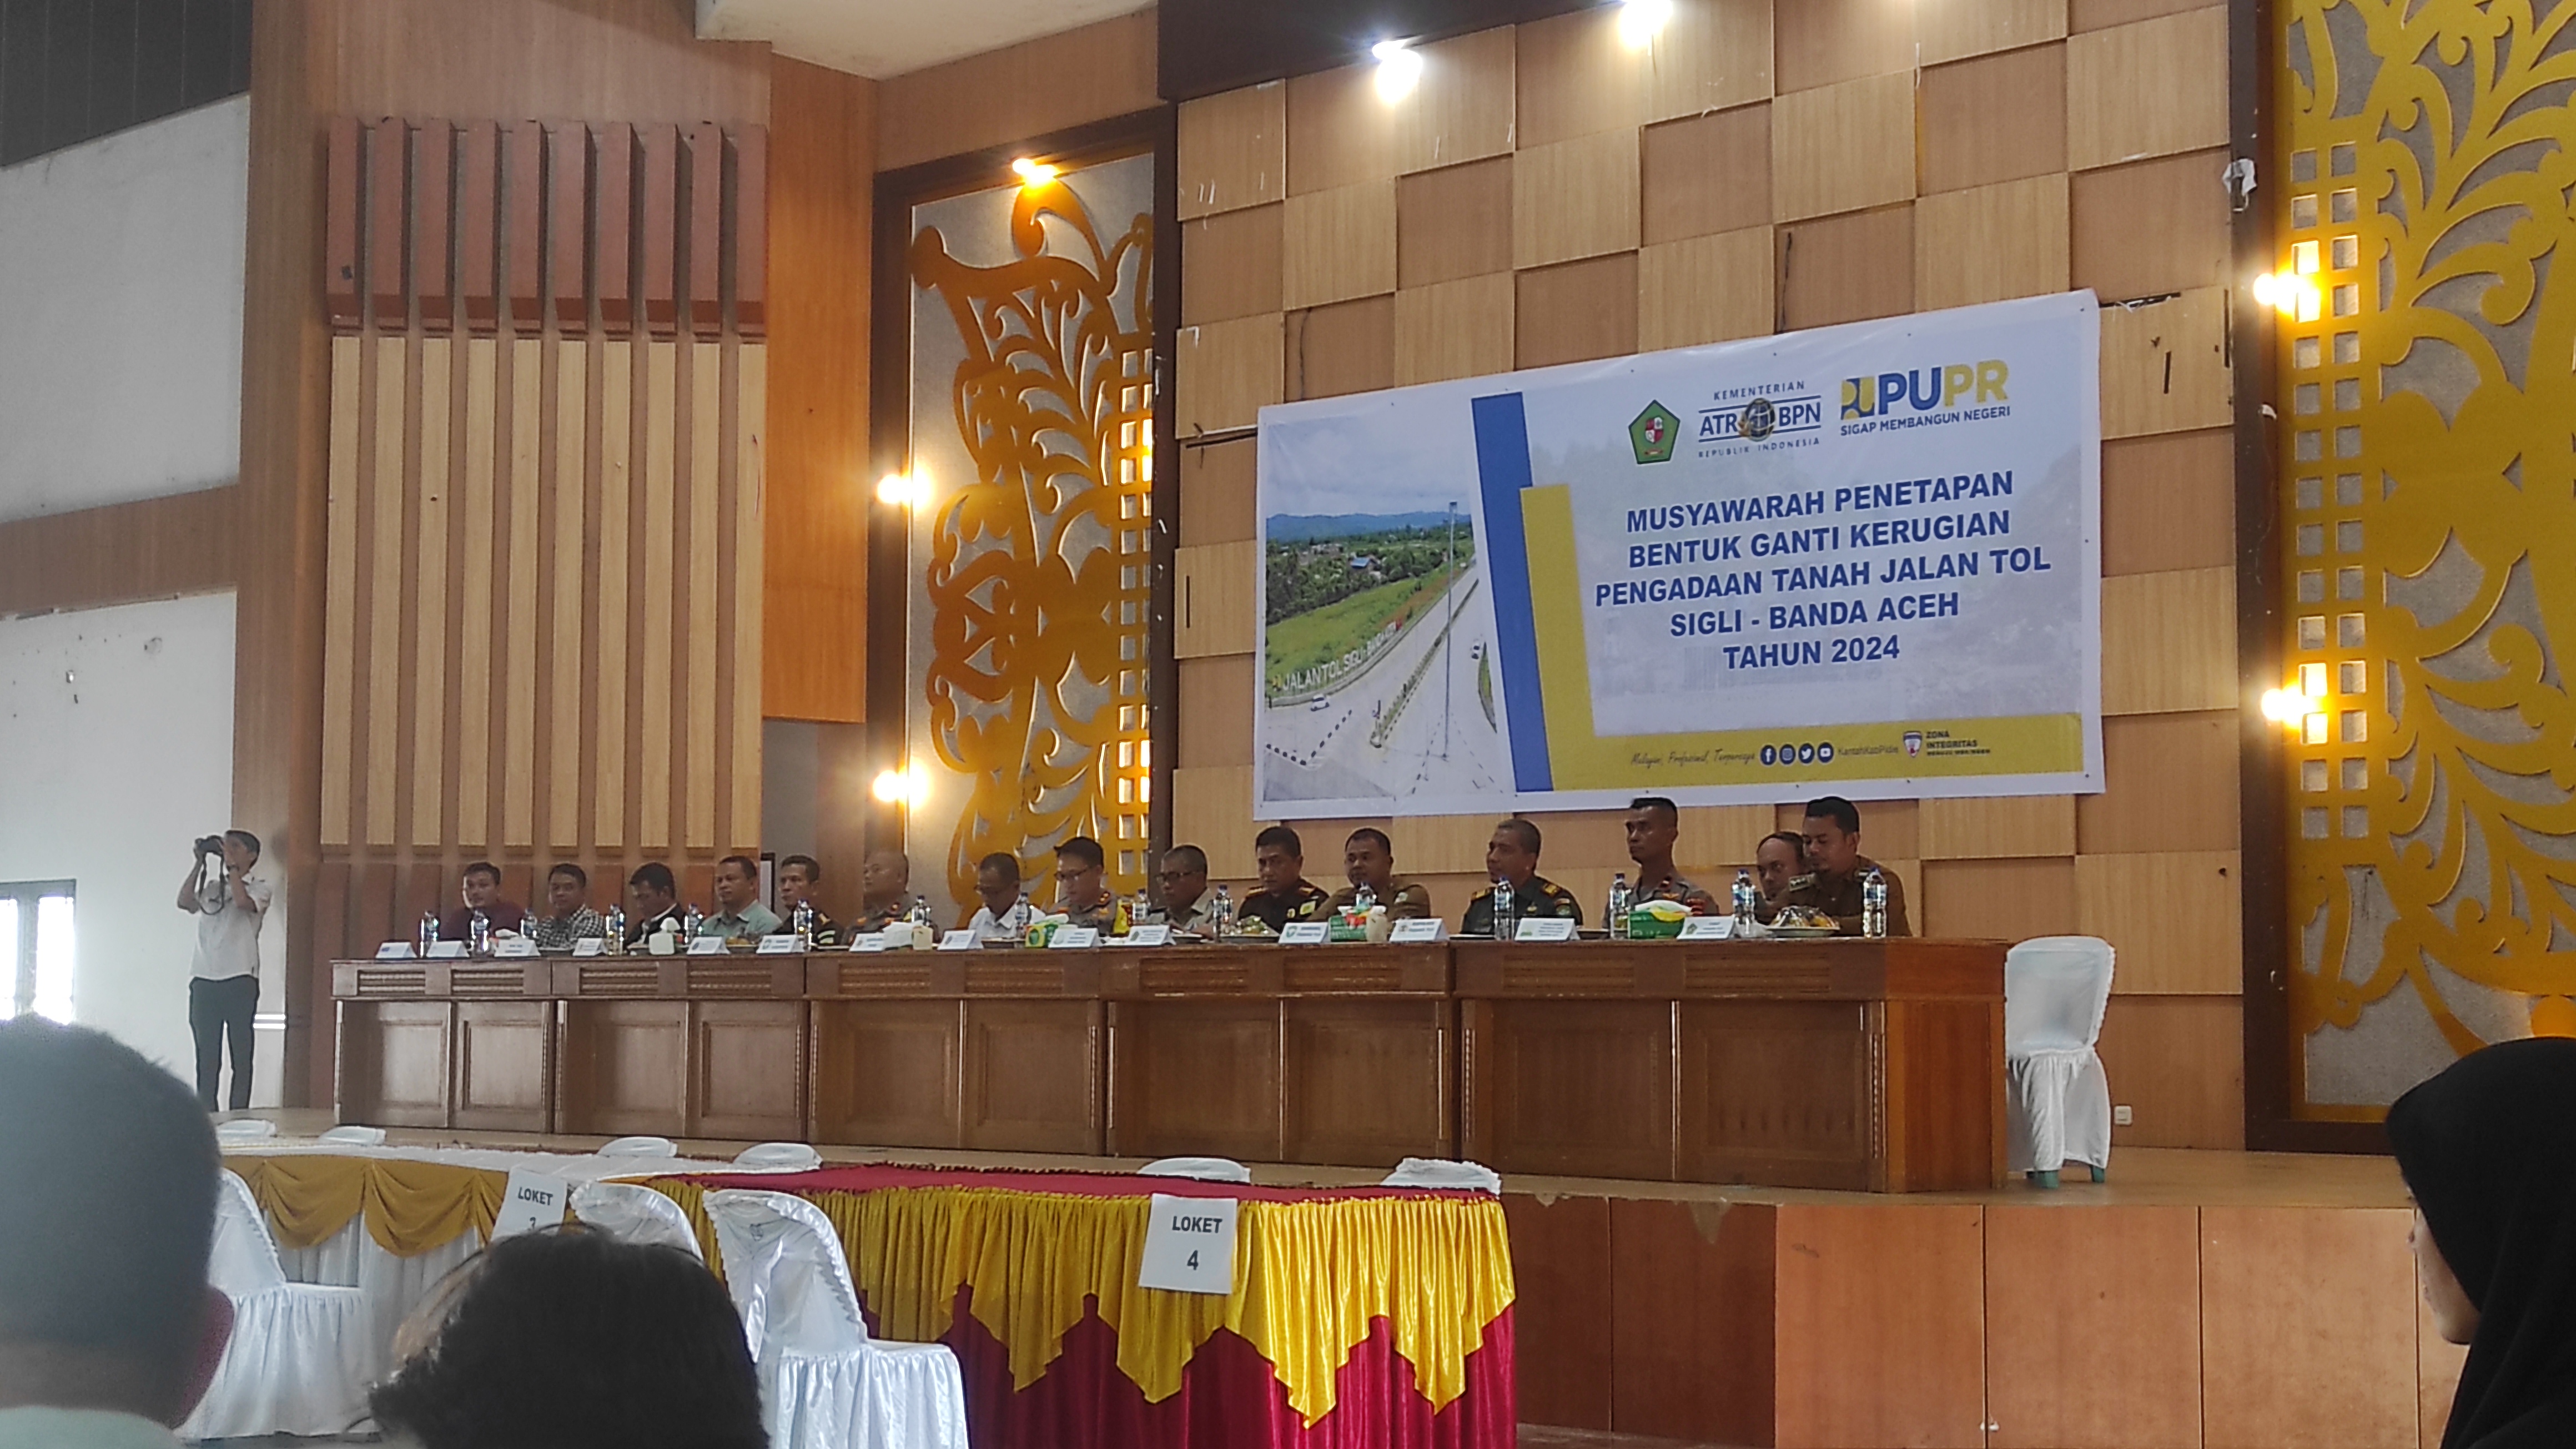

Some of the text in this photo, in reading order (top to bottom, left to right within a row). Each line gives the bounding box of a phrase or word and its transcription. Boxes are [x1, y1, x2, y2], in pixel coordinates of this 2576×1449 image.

[1714, 381, 1804, 400] KEMENTERIAN
[1879, 359, 2009, 415] PUPR
[1699, 402, 1821, 436] ATR BPN
[1841, 406, 2010, 436] SIGAP MEMBANGUN NEGERI
[1699, 437, 1819, 457] REPUBLIK INDONESIA
[1628, 471, 2012, 532] MUSYAWARAH PENETAPAN
[1630, 510, 2009, 568] BENTUK GANTI KERUGIAN
[1596, 547, 2051, 606] PENGADAAN TANAH JALAN TOL
[1671, 610, 1741, 636] SIGLI
[1770, 600, 1868, 629] BANDA
[1877, 592, 1958, 621] ACEH
[1723, 635, 1899, 669] TAHUN 2024
[1283, 668, 1321, 691] JALAN
[1926, 739, 1978, 748] INTEGRITAS
[518, 1187, 553, 1205] LOKET
[1173, 1216, 1222, 1233] LOKET
[1187, 1250, 1198, 1270] 4
